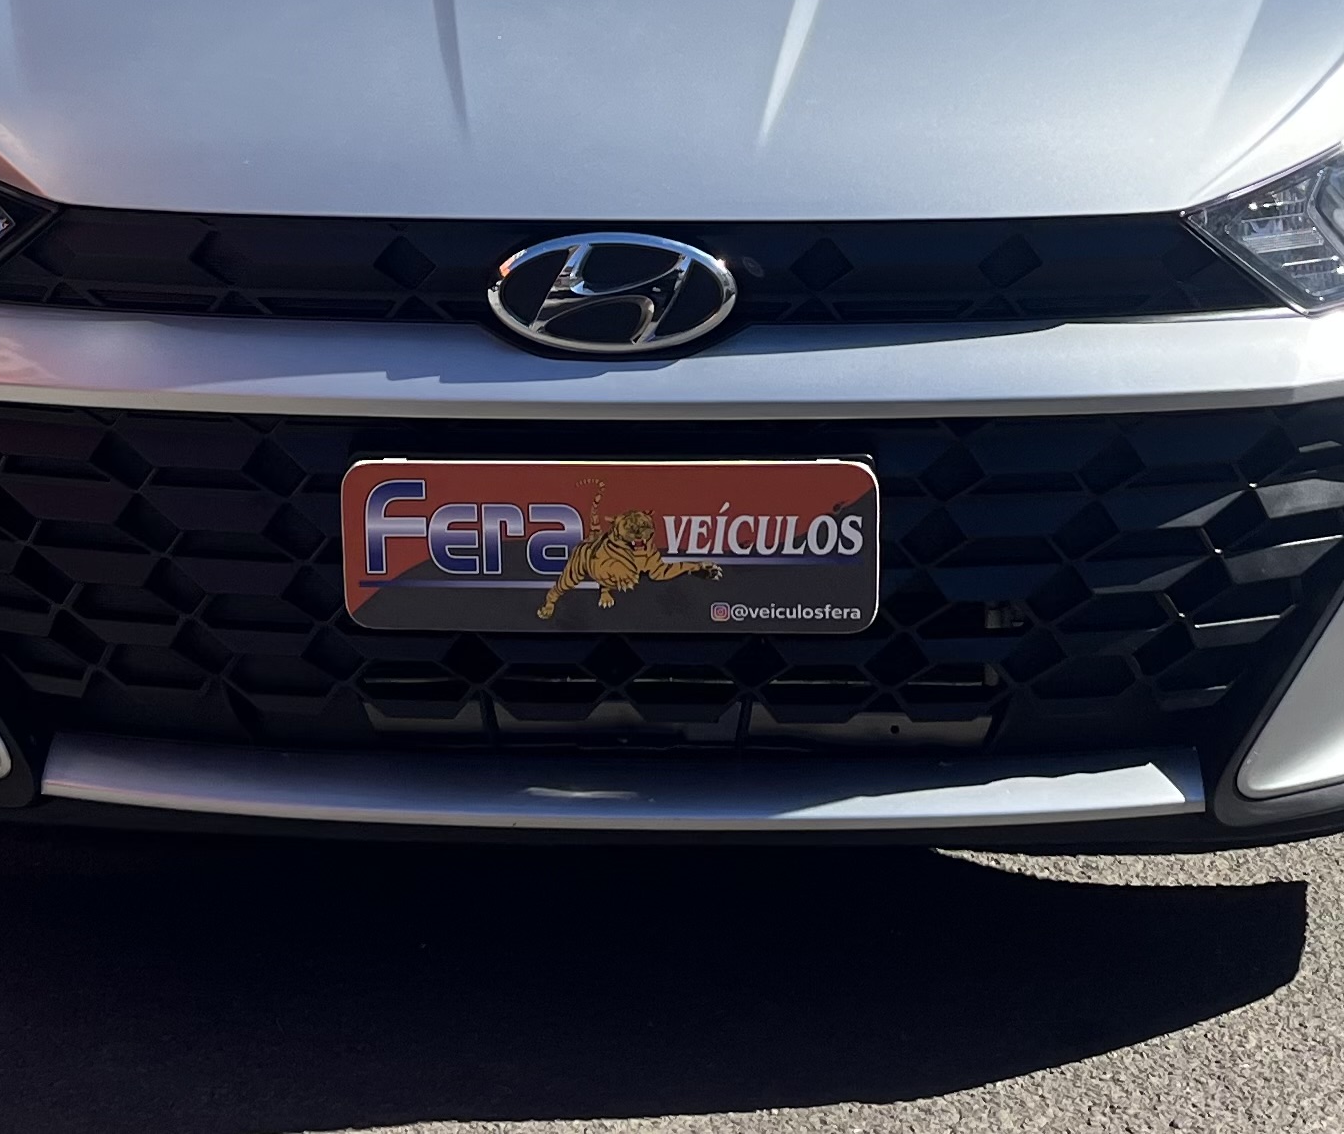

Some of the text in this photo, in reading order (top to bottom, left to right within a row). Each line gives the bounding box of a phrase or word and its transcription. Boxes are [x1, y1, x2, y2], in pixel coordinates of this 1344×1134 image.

[364, 478, 865, 575] Fera VEÍCULOS
[731, 602, 862, 621] @veiculosfera
